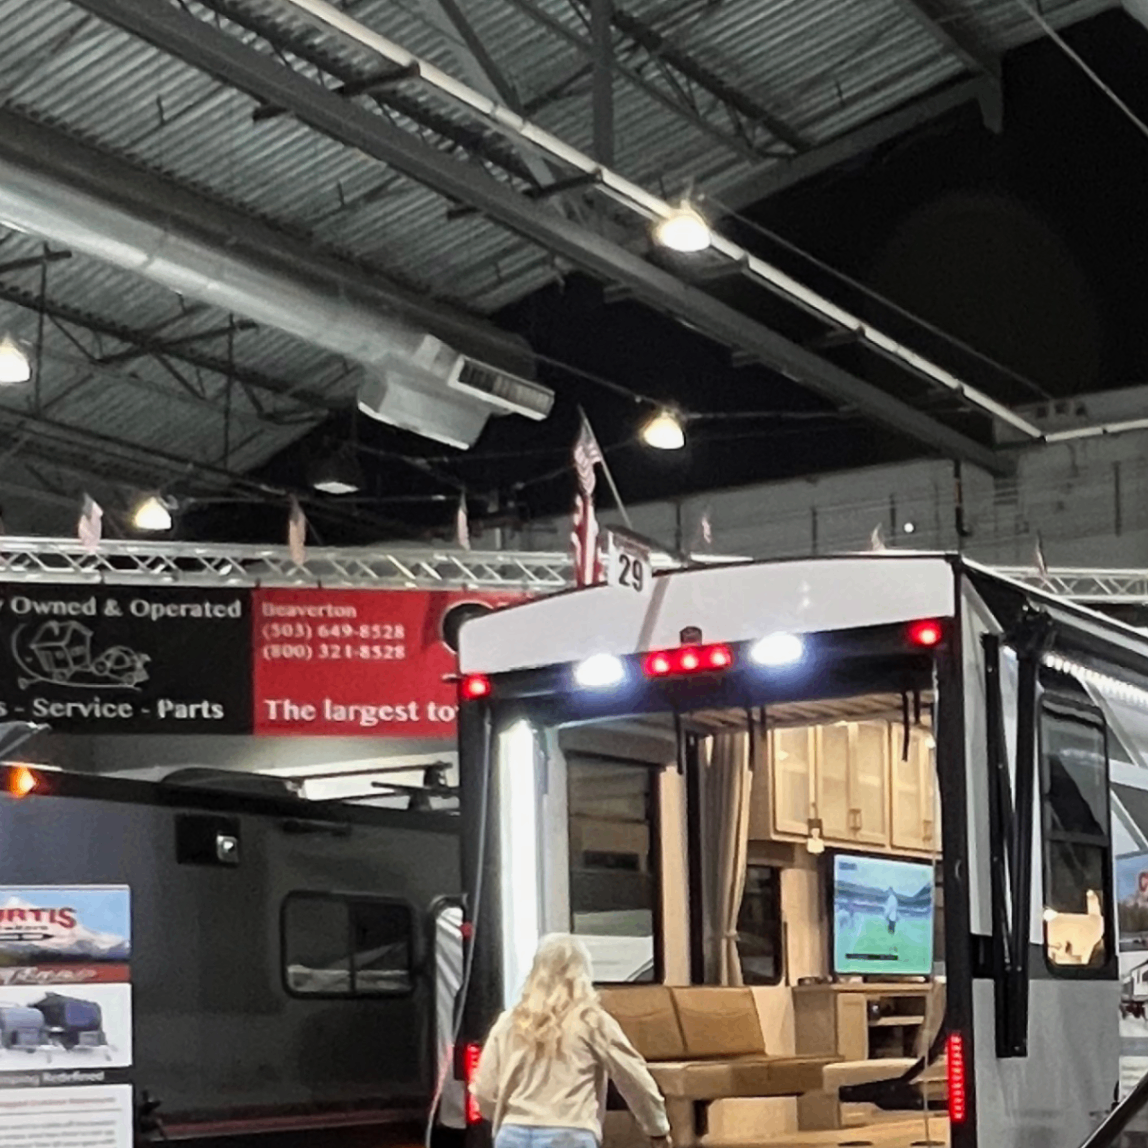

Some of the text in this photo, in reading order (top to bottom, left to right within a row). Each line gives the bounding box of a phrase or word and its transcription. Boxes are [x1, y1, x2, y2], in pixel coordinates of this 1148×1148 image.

[619, 554, 642, 592] 29
[11, 596, 242, 621] Owned & Operated
[262, 602, 358, 618] Beaverton
[32, 697, 134, 718] Service
[157, 699, 225, 719] Parts
[264, 698, 459, 726] The largest to
